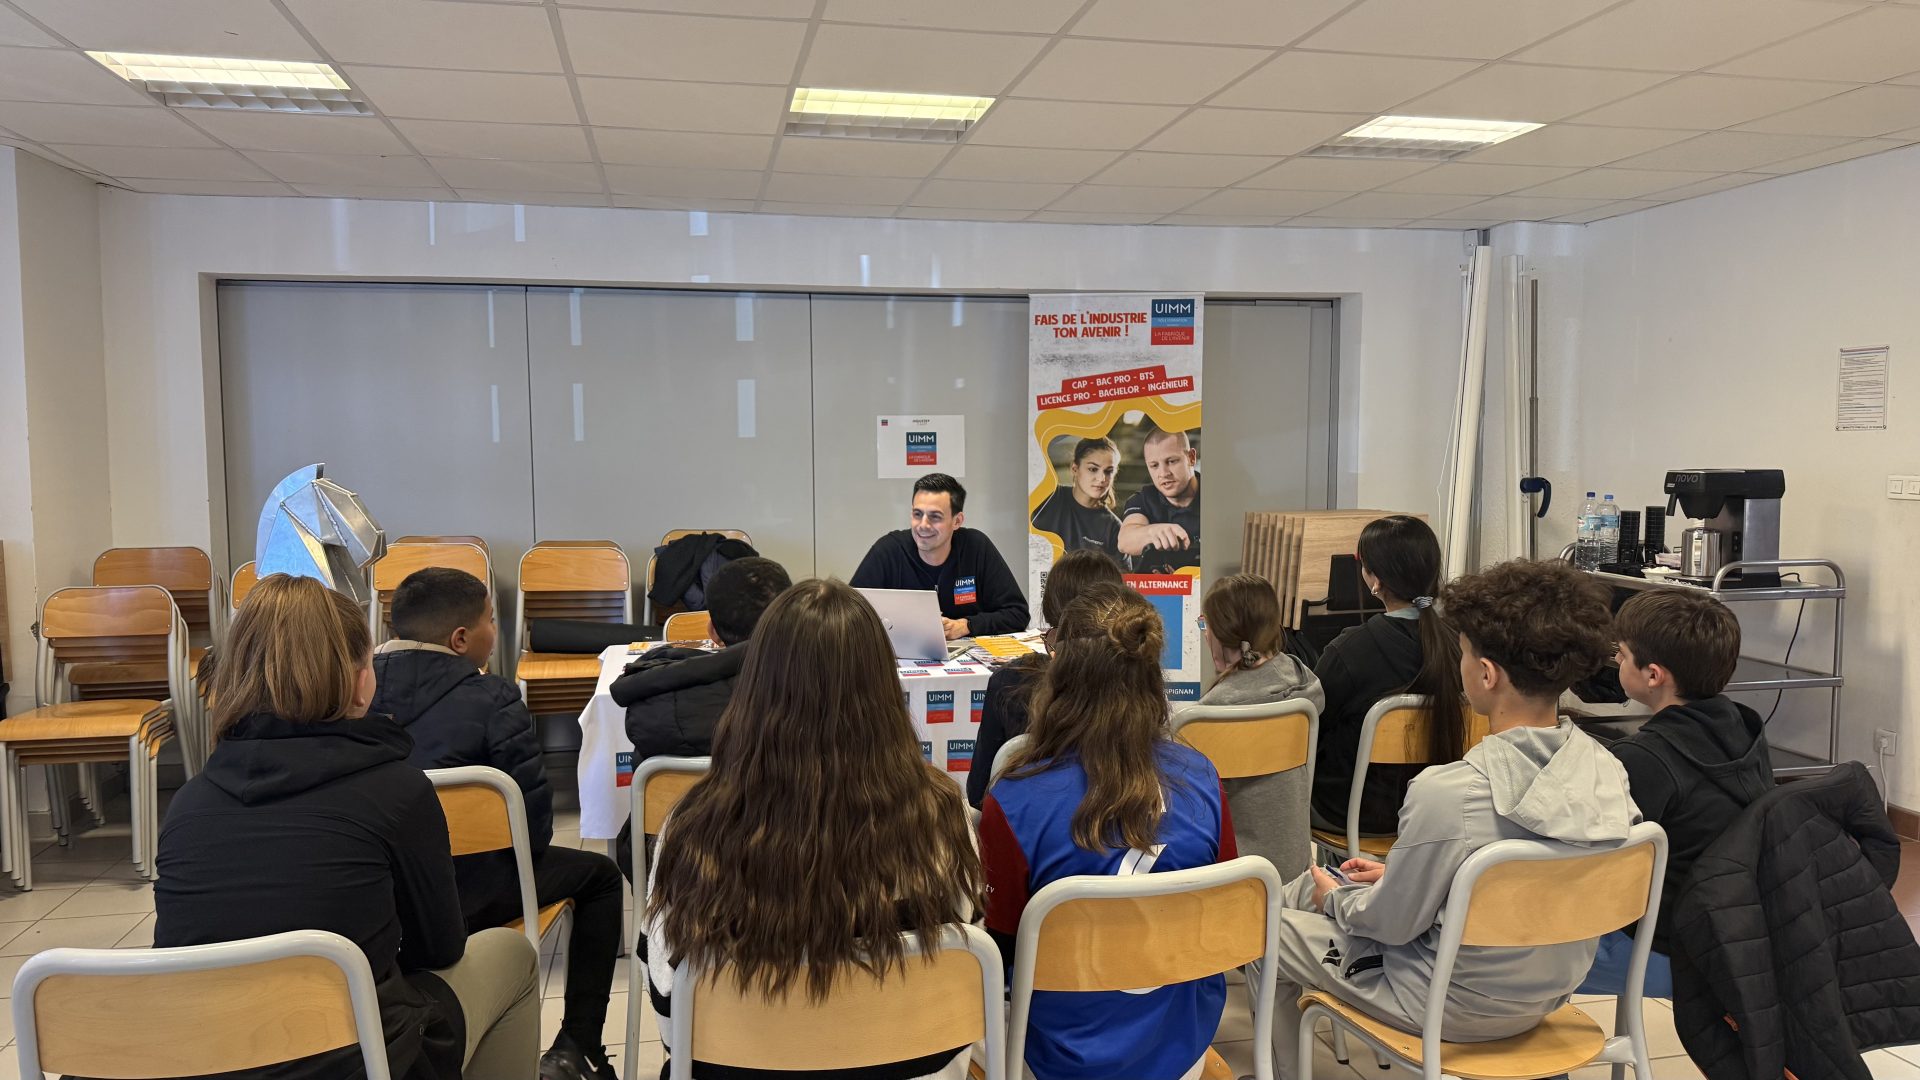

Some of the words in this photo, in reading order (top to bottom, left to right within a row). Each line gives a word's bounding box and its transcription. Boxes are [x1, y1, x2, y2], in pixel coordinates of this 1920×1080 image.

[1155, 303, 1191, 314] UIMM
[1034, 314, 1058, 325] FAIS
[1062, 314, 1077, 325] DE
[1080, 311, 1147, 324] L'INDUSTRIE
[1053, 327, 1077, 338] TON
[1081, 326, 1121, 338] AVENIR
[1071, 379, 1088, 390] CAP
[1096, 377, 1112, 387] BAC
[1114, 374, 1131, 385] PRO
[1139, 371, 1155, 380] BTS
[1040, 394, 1071, 406] LICENCE
[1073, 392, 1090, 401] PRO
[1098, 386, 1140, 398] BACHELOR
[1148, 379, 1189, 392] INGÉNIEUR
[908, 434, 935, 443] UIMM
[955, 578, 975, 587] UIMM
[1138, 580, 1189, 589] ALTERNANCE
[928, 693, 952, 702] UIMM
[973, 692, 986, 701] UI
[949, 742, 974, 750] UIMM
